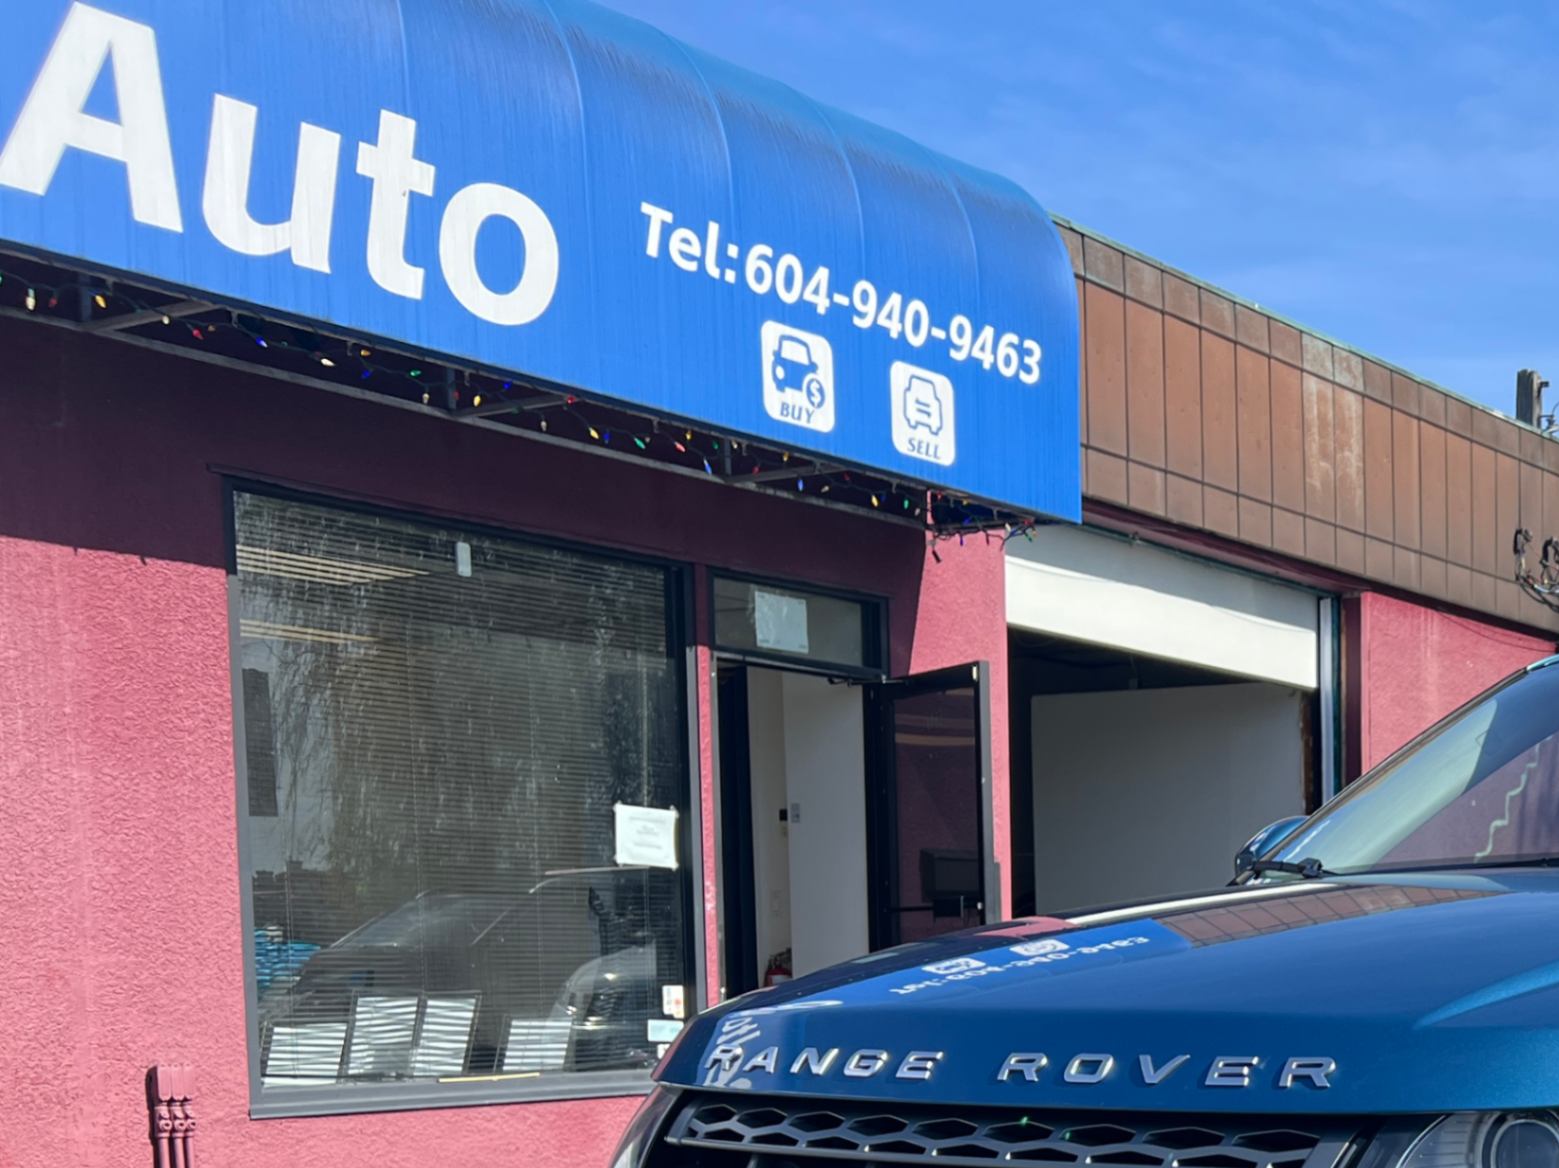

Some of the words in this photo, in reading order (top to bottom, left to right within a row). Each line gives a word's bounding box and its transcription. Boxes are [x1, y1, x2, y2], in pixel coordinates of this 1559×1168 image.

[0, 1, 560, 325] Auto
[779, 401, 816, 425] BUY
[907, 437, 942, 460] SELL
[704, 1045, 944, 1080] RANGE
[997, 1051, 1338, 1088] ROVER
